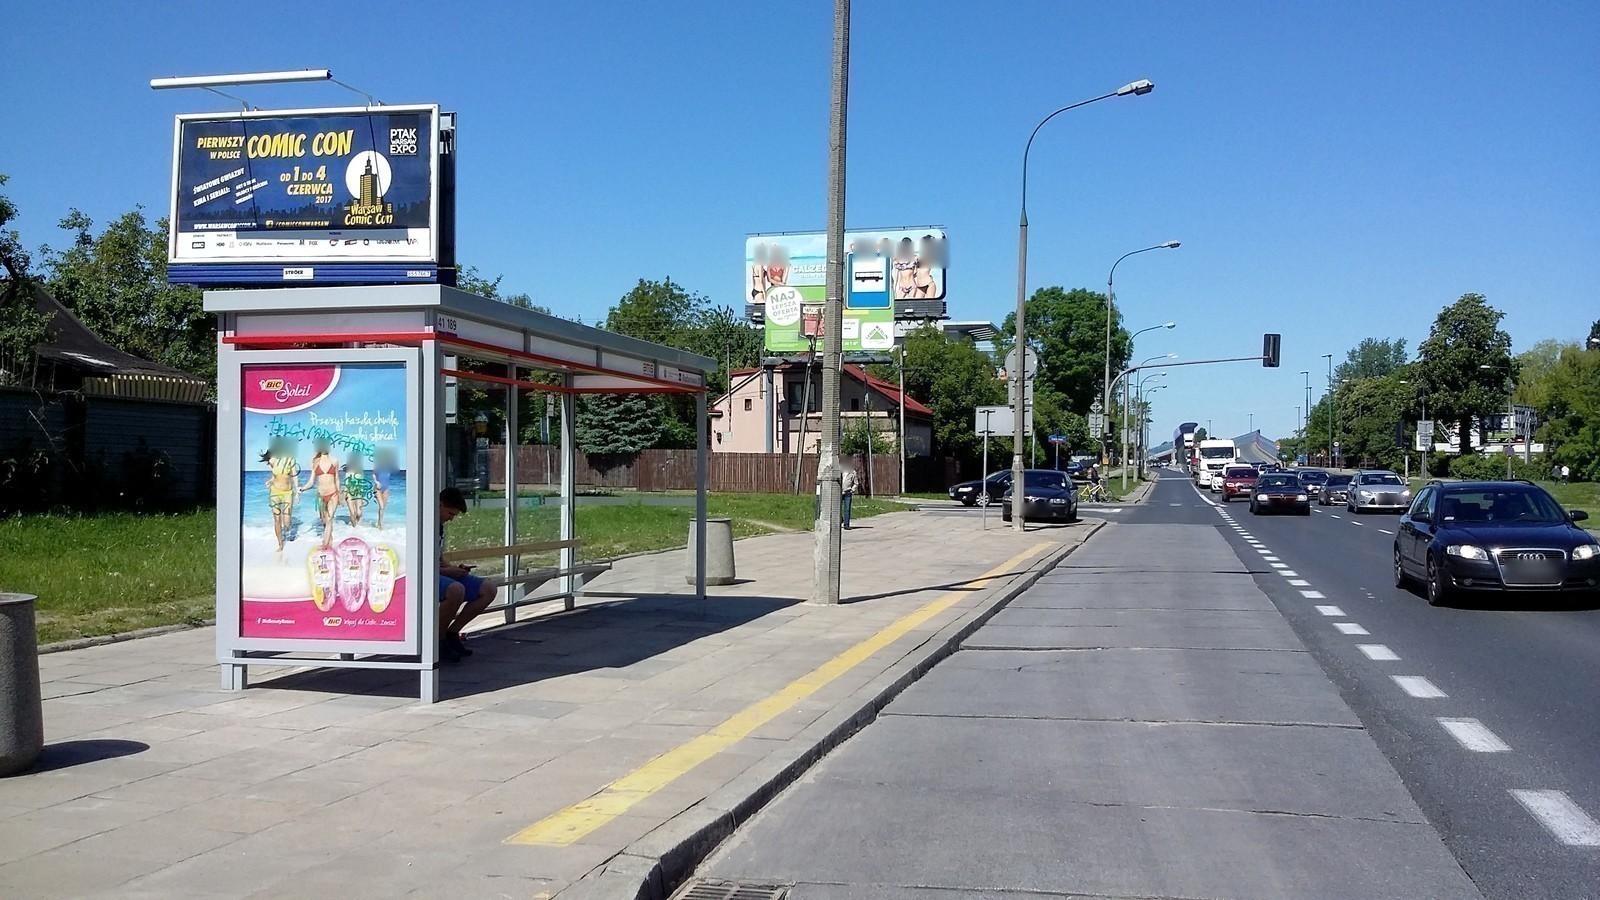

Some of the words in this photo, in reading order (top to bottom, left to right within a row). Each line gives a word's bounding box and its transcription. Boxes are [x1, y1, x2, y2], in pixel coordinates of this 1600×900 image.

[390, 128, 417, 139] PTAK
[197, 136, 245, 149] PIERWSZY
[247, 132, 307, 159] COMIC
[312, 129, 354, 157] CON
[390, 144, 417, 154] EXPO
[210, 151, 217, 159] W
[217, 150, 241, 159] POLSCE
[280, 173, 291, 182] OD
[293, 166, 300, 182] 1
[302, 172, 313, 181] DO
[315, 165, 327, 181] 4
[287, 183, 333, 196] CZERWCA
[315, 195, 333, 204] 2017
[351, 203, 383, 216] Warsaw
[344, 213, 373, 226] Comic
[375, 213, 393, 225] Con
[770, 290, 796, 304] NAJ
[275, 382, 312, 402] Soleil
